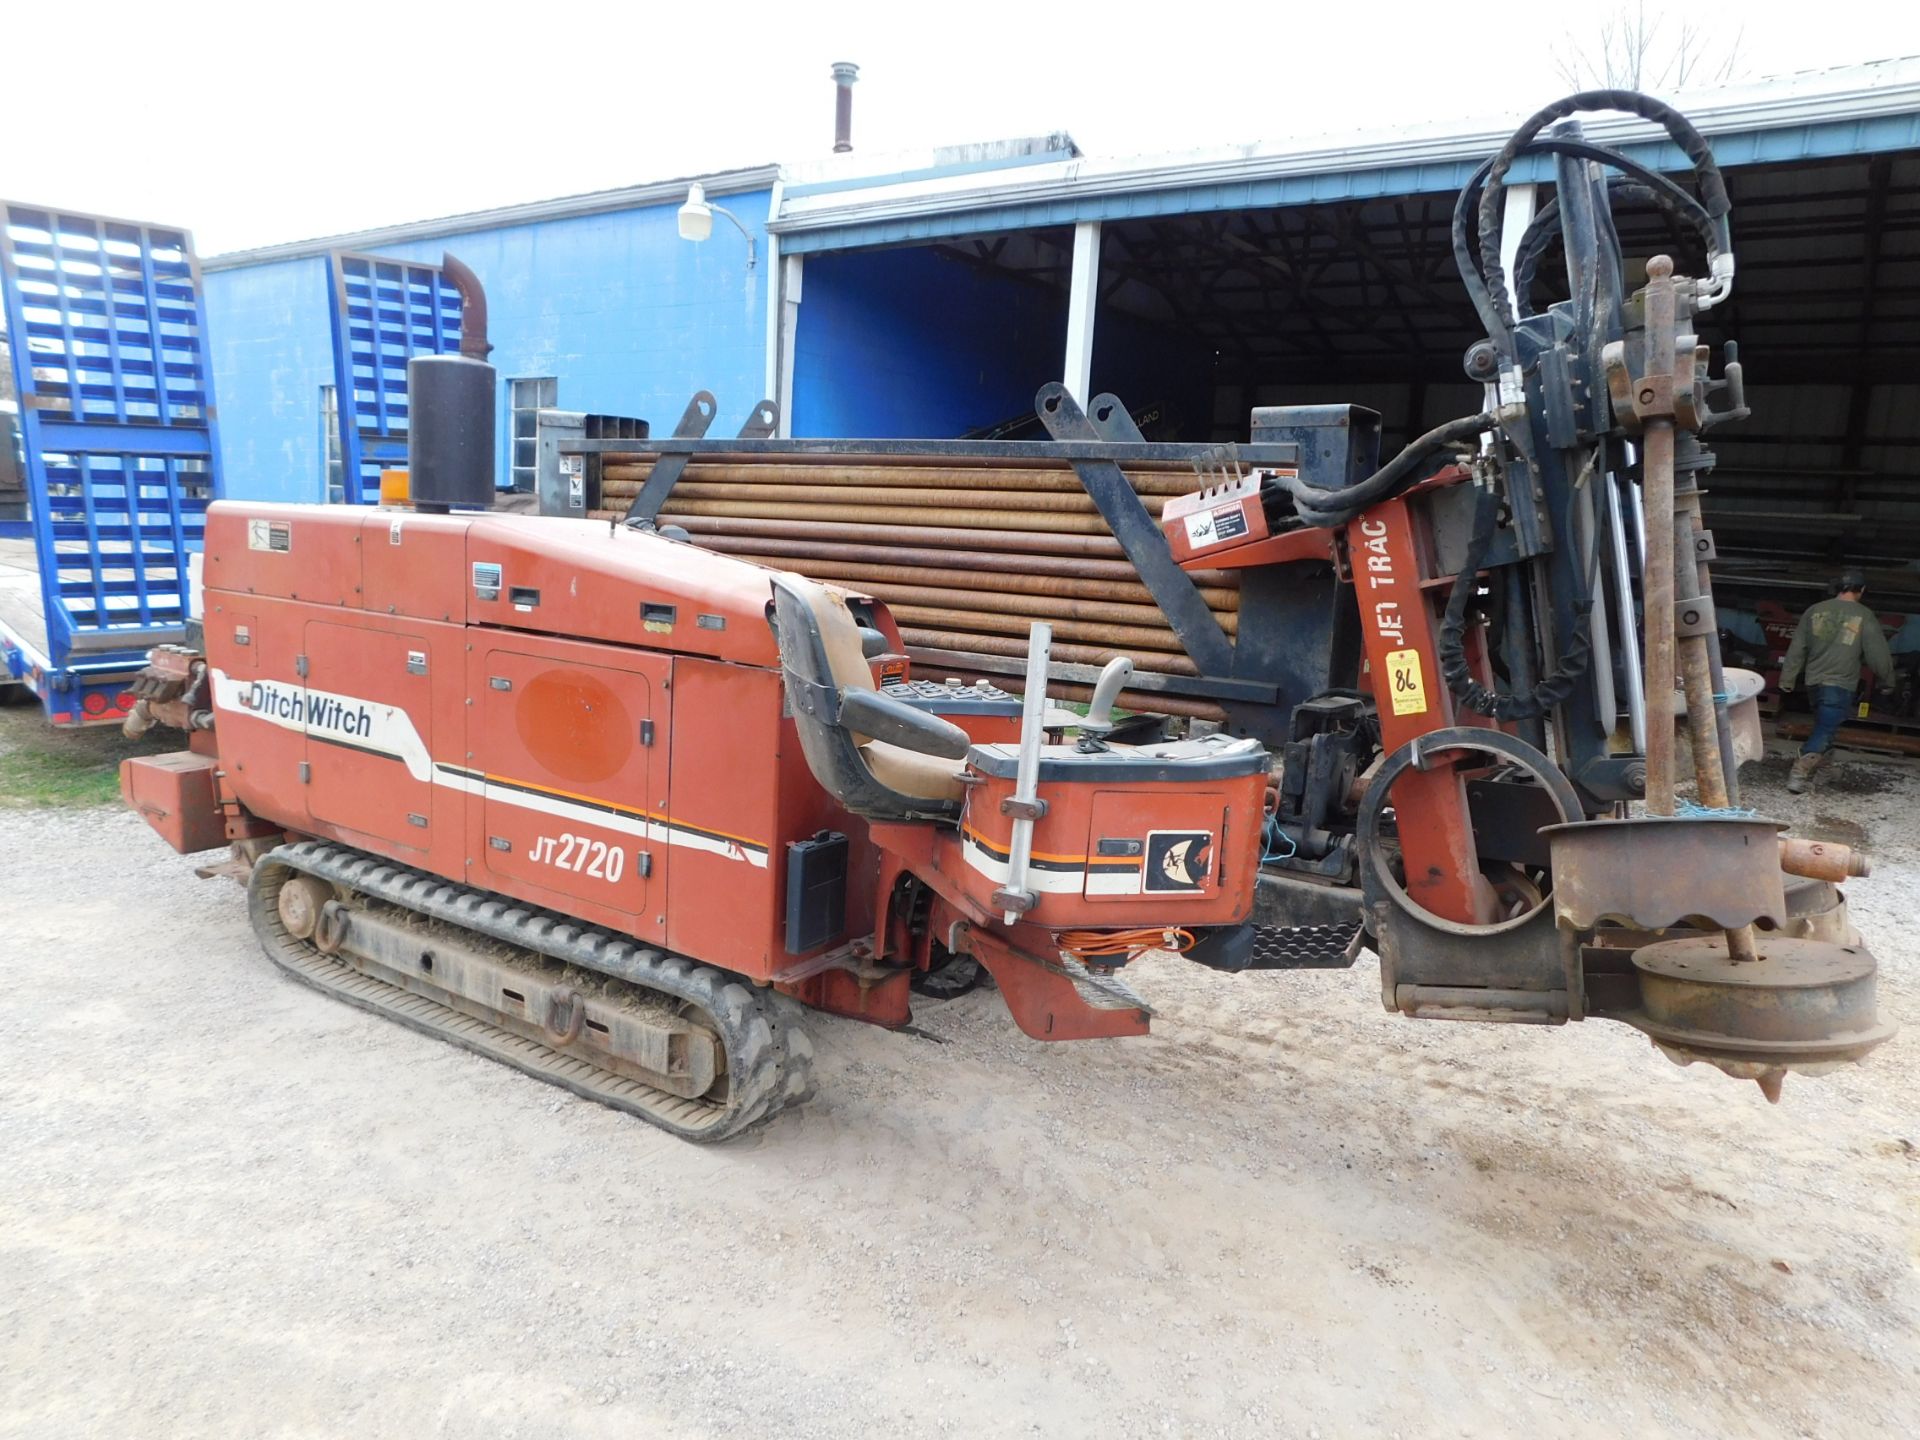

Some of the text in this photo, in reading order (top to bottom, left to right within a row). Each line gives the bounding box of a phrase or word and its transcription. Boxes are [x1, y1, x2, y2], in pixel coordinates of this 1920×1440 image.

[1361, 519, 1396, 589] TRAC
[1395, 668, 1417, 693] 86
[251, 682, 371, 738] Ditch Witch
[528, 832, 625, 883] JT2720
